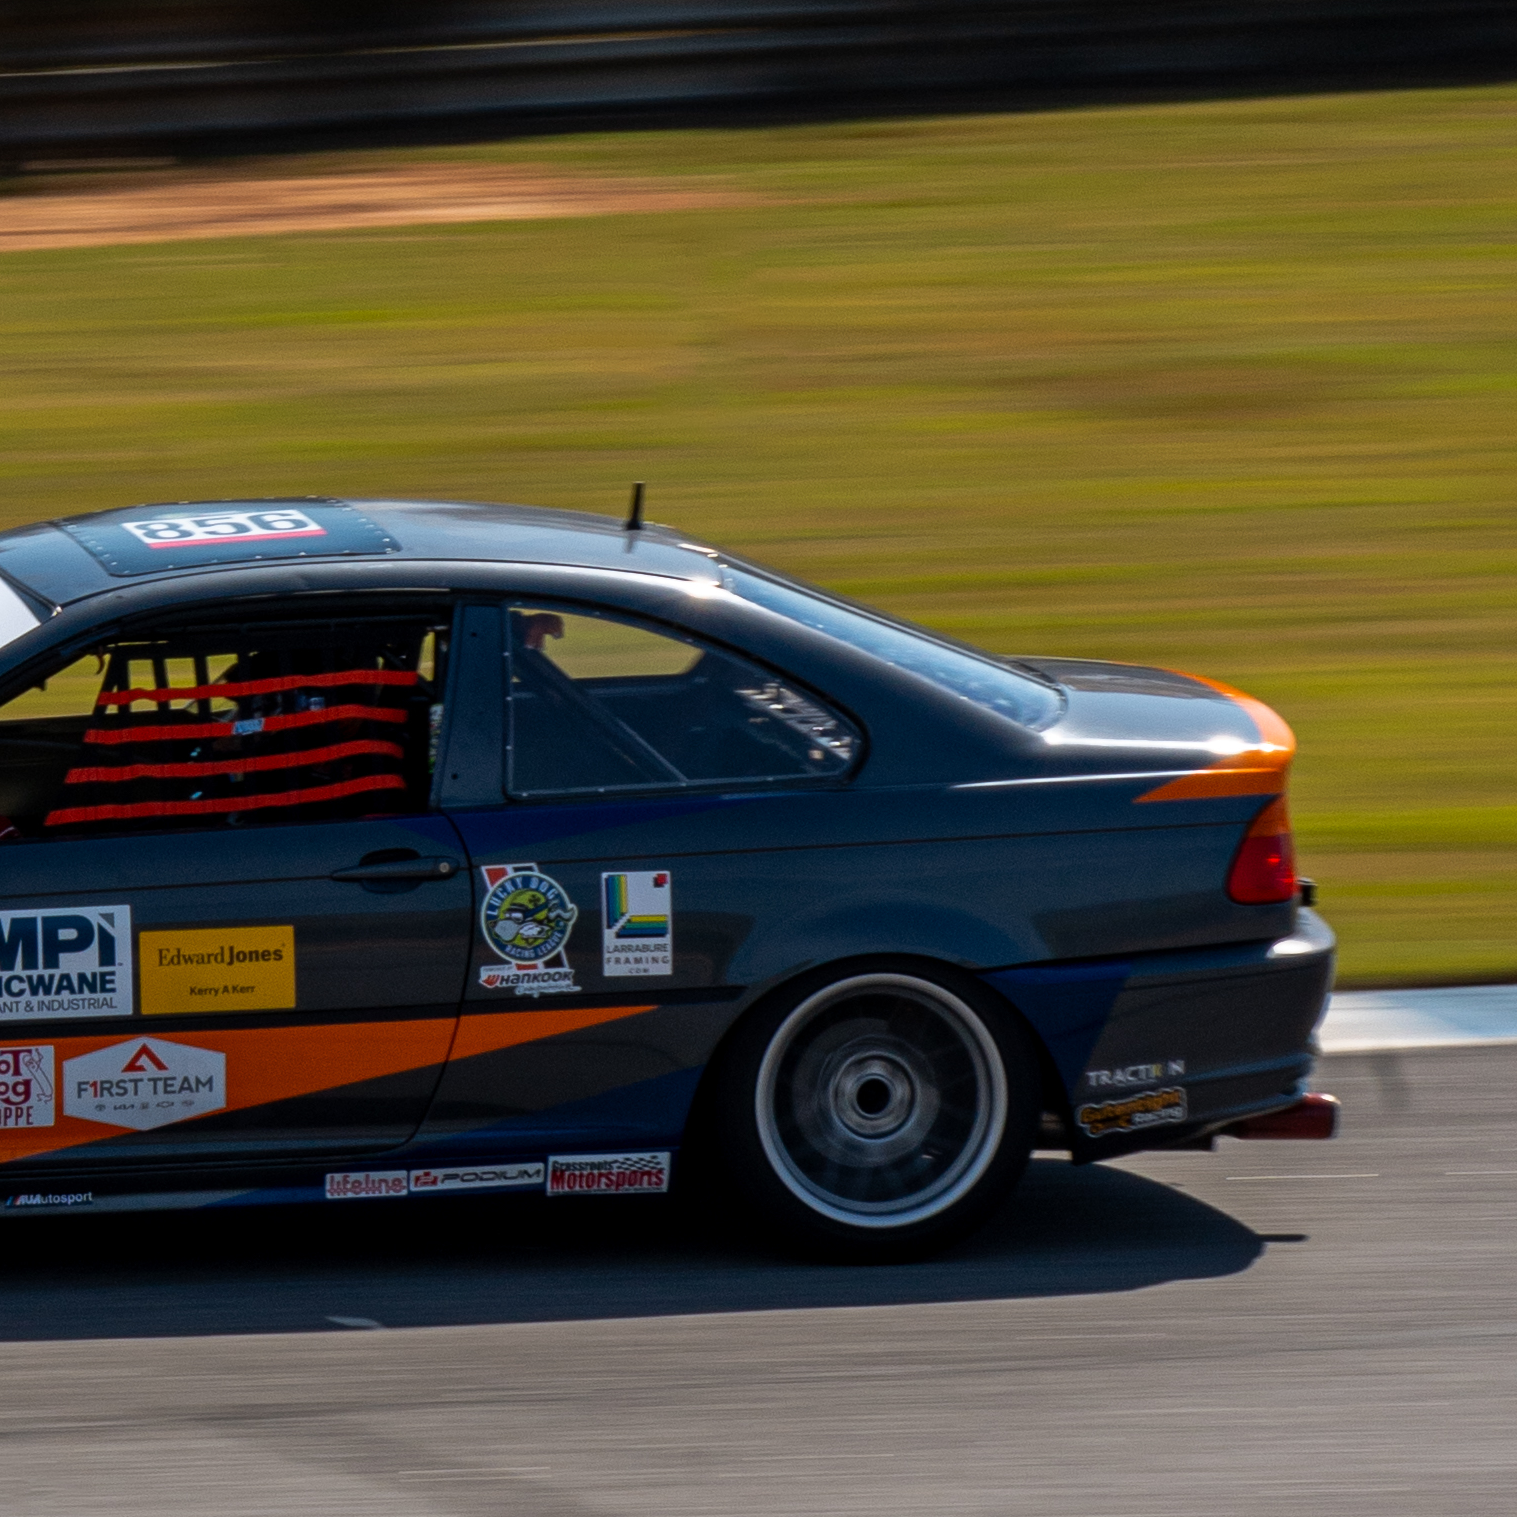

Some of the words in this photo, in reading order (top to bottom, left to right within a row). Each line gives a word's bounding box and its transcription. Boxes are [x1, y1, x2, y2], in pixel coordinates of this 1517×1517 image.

[134, 512, 310, 540] 856
[486, 876, 523, 916] LUCKY
[529, 876, 559, 900] DOG
[605, 955, 670, 965] FRAMING
[189, 985, 220, 997] Kerry
[222, 985, 230, 995] A
[232, 984, 256, 995] Kerr
[24, 1001, 35, 1013] &
[37, 997, 118, 1012] INDUSTRIAL
[1085, 1059, 1185, 1087] TRACTIN
[147, 1075, 214, 1095] TEAM
[440, 1168, 542, 1185] PODIUM
[550, 1169, 665, 1192] Motorsports
